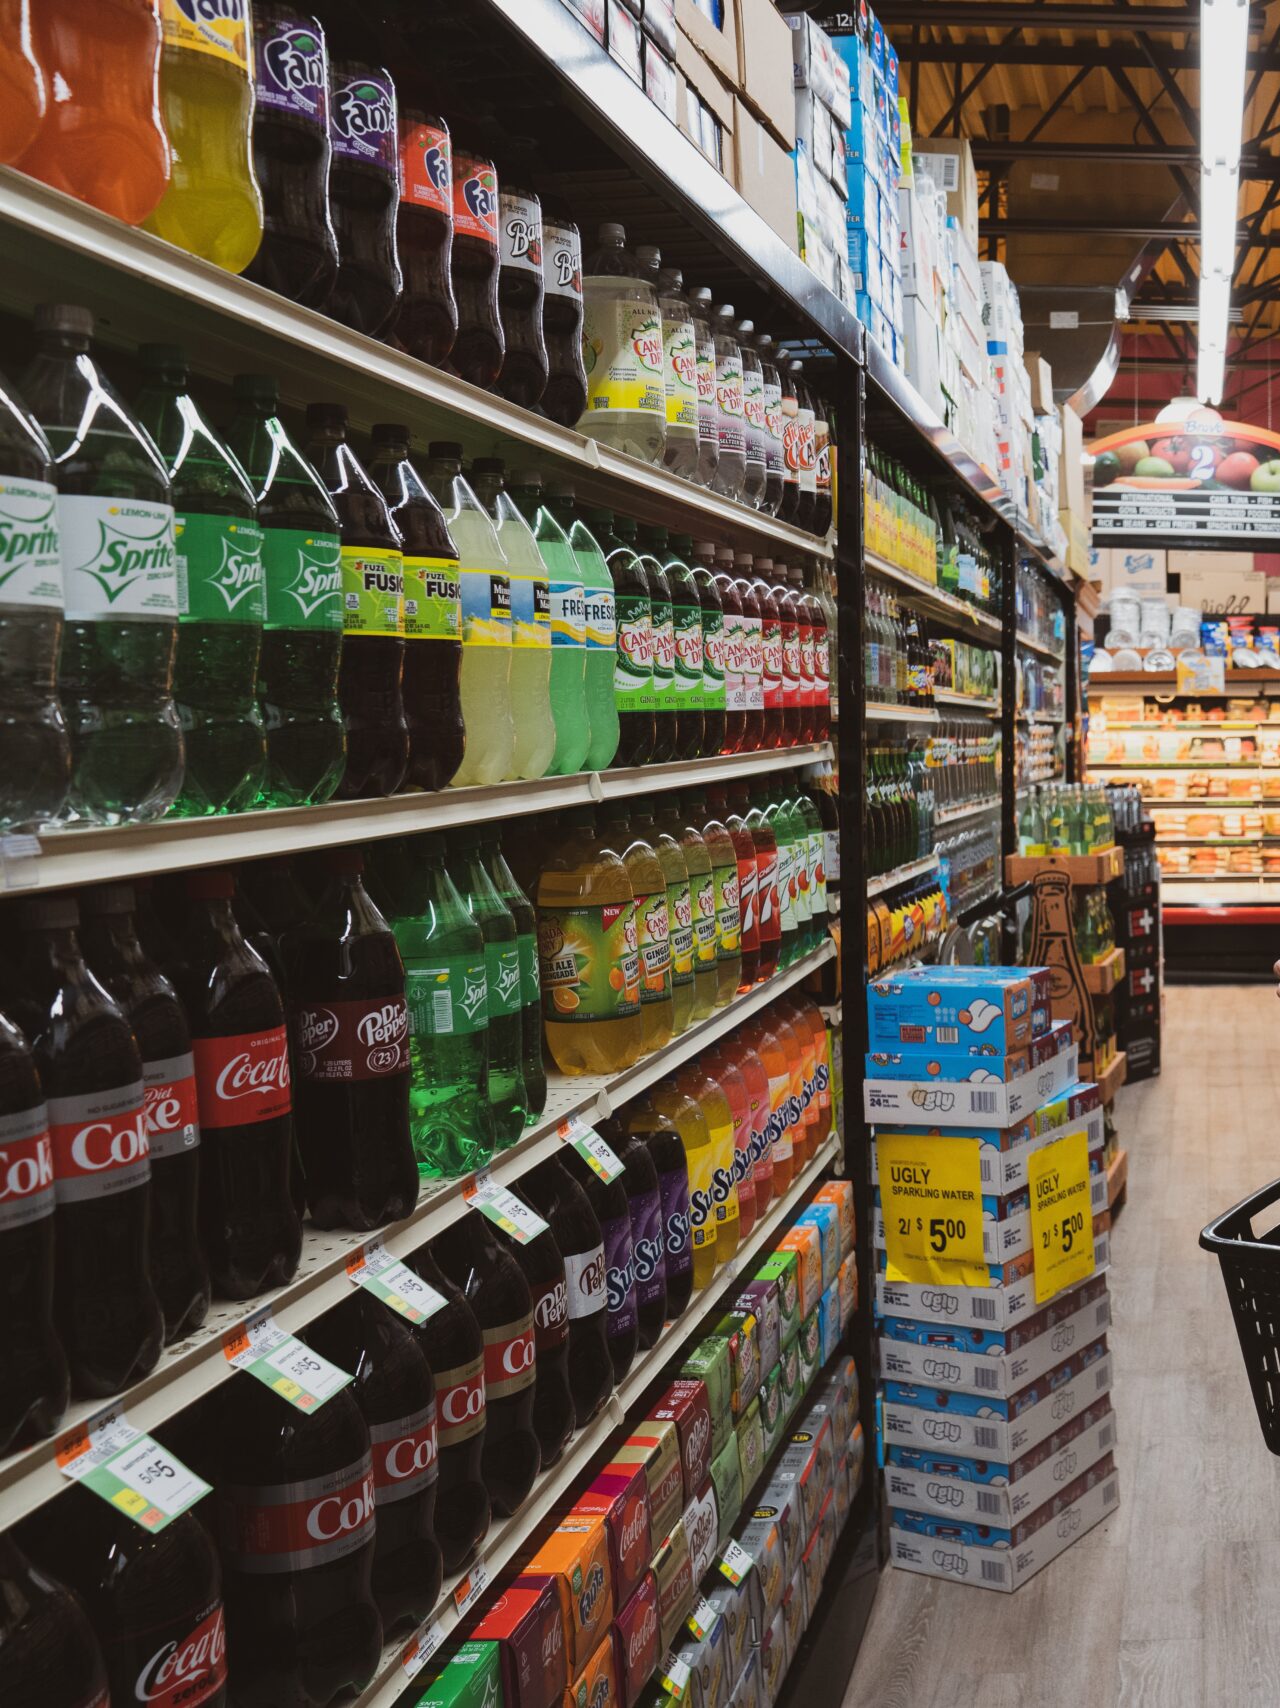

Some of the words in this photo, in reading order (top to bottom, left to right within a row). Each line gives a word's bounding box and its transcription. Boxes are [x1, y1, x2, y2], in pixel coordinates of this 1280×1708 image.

[1190, 445, 1215, 480] 2
[1139, 507, 1176, 515] PRODUCTS
[364, 563, 386, 572] FUZE
[426, 572, 445, 580] FUZE
[556, 960, 574, 971] ALE
[378, 1052, 391, 1064] 23
[890, 1167, 931, 1185] UGLY
[1036, 1173, 1060, 1199] UGLY
[893, 1186, 939, 1199] SPARKLING
[942, 1190, 974, 1201] WATER
[1037, 1189, 1066, 1212] SPARKLING
[1067, 1181, 1086, 1197] WATER
